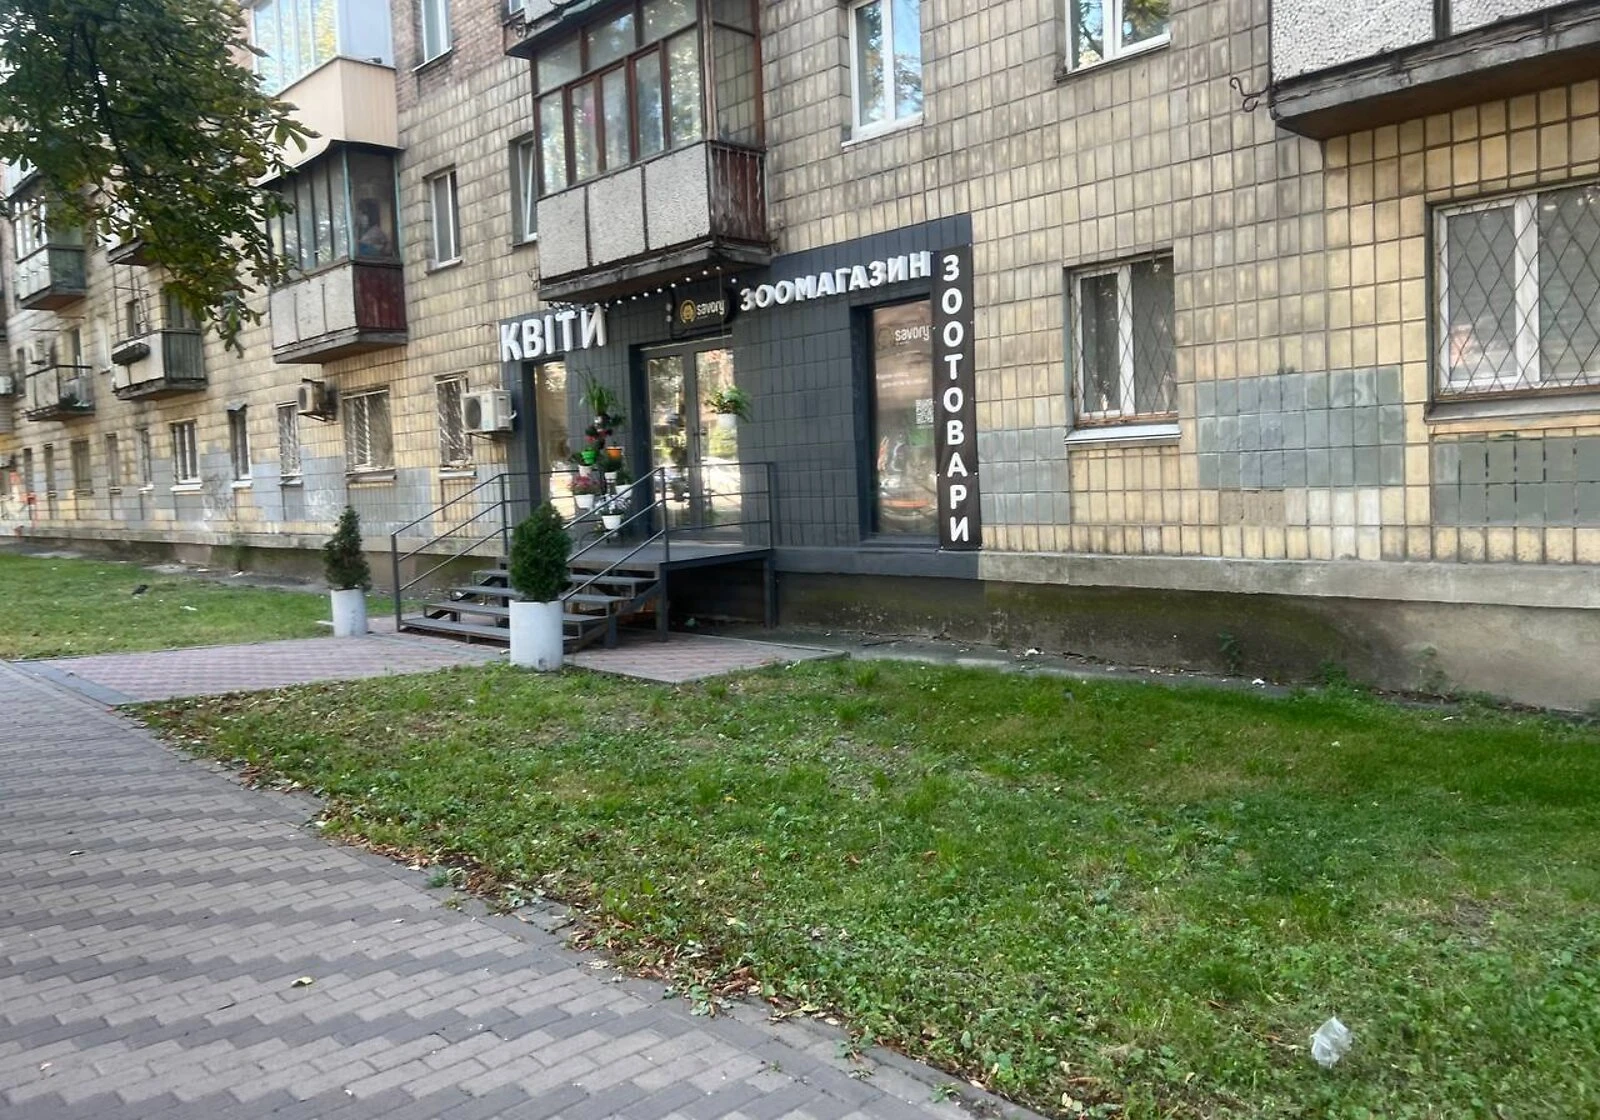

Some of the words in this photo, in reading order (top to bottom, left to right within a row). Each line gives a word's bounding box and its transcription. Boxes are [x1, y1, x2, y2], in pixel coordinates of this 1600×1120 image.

[696, 300, 725, 316] savory
[739, 251, 931, 311] ЗООМАГАЗИН
[500, 305, 606, 362] КВІТИ
[895, 325, 930, 341] savory
[941, 254, 969, 542] ЗООТОВАРИ
